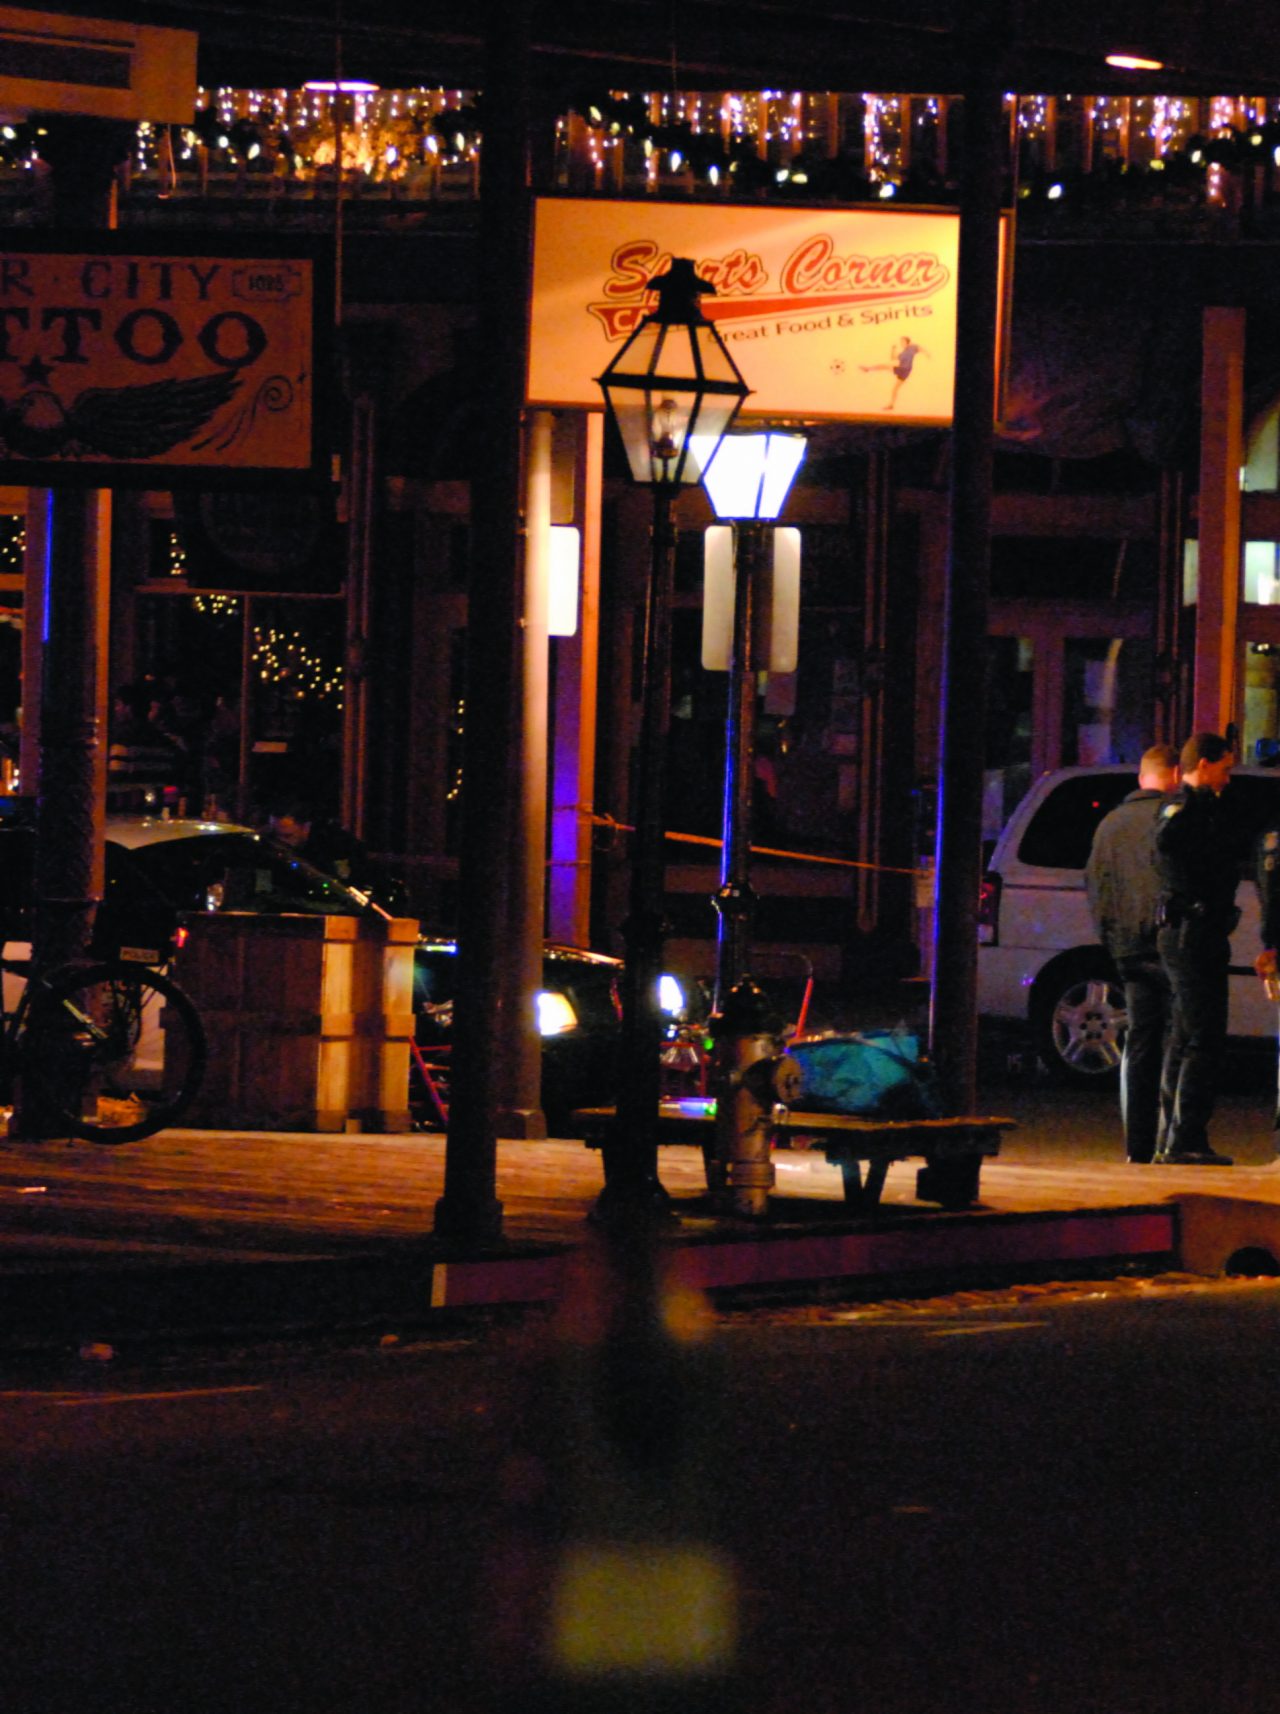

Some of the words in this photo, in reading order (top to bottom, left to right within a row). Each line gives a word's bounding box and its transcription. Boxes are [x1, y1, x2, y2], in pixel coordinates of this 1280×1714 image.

[80, 261, 221, 300] CITY
[604, 241, 766, 302] Srts
[783, 236, 946, 297] Corner
[775, 315, 832, 336] Food
[837, 313, 854, 327] &
[860, 304, 933, 325] Spirits
